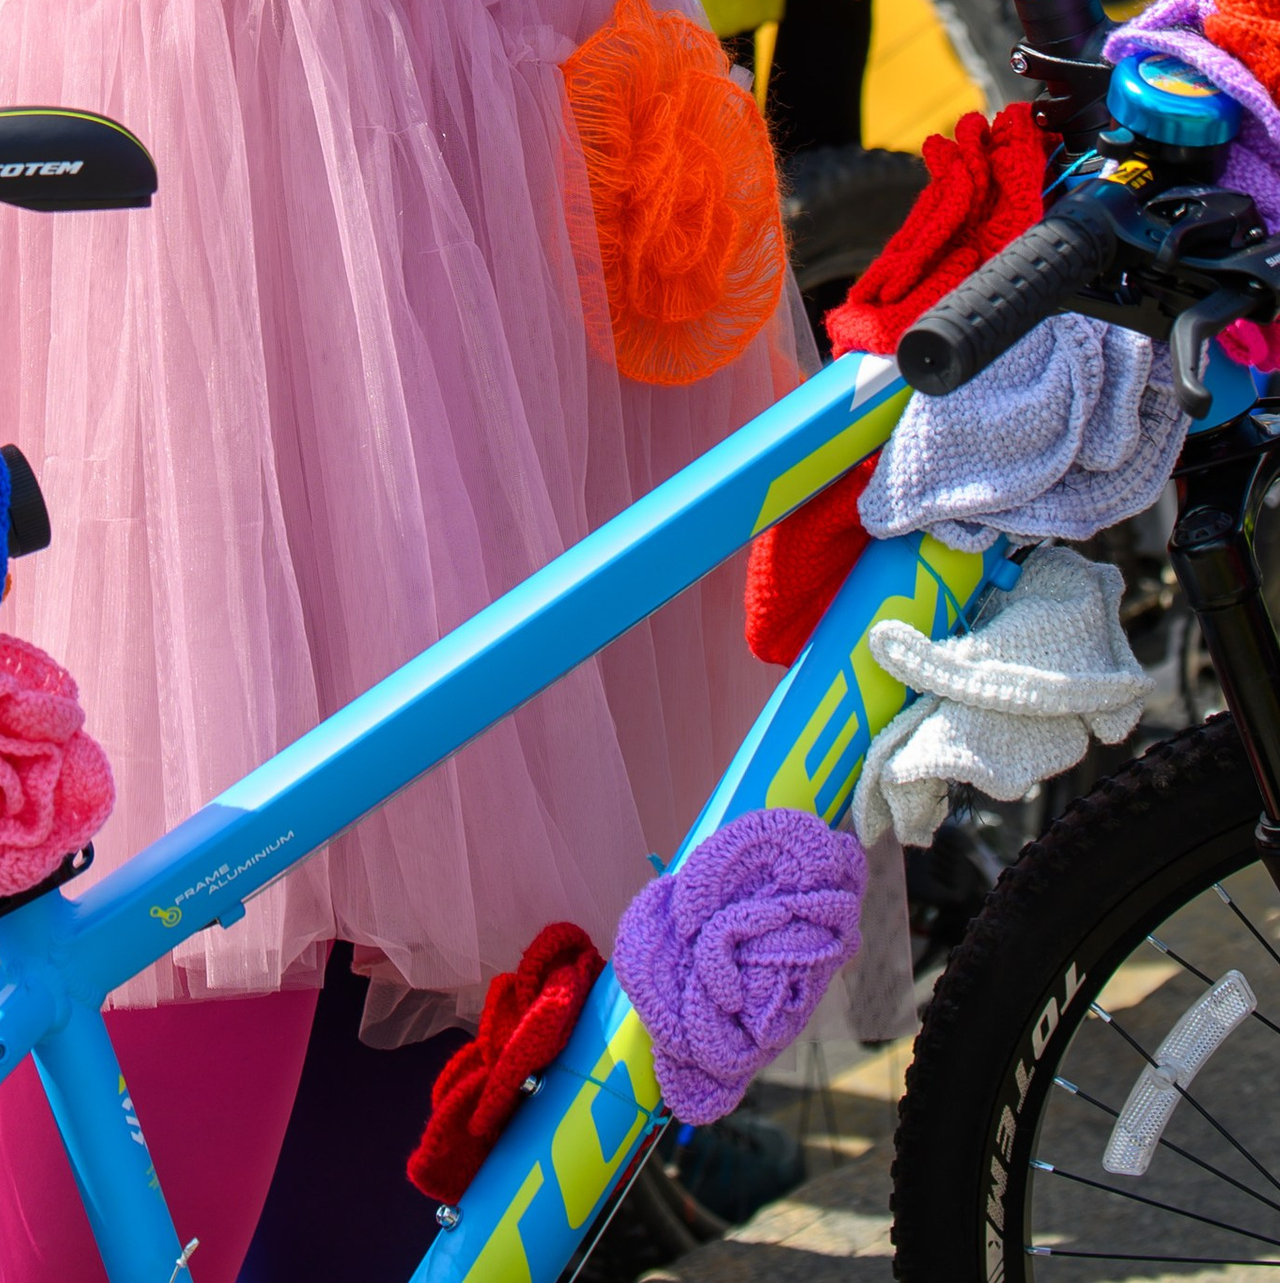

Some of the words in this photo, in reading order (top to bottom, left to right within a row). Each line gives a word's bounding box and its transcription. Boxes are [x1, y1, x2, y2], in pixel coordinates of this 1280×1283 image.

[174, 863, 231, 906] FRAME
[208, 830, 295, 896] ALUMINIUM
[985, 961, 1087, 1233] TOTEM
